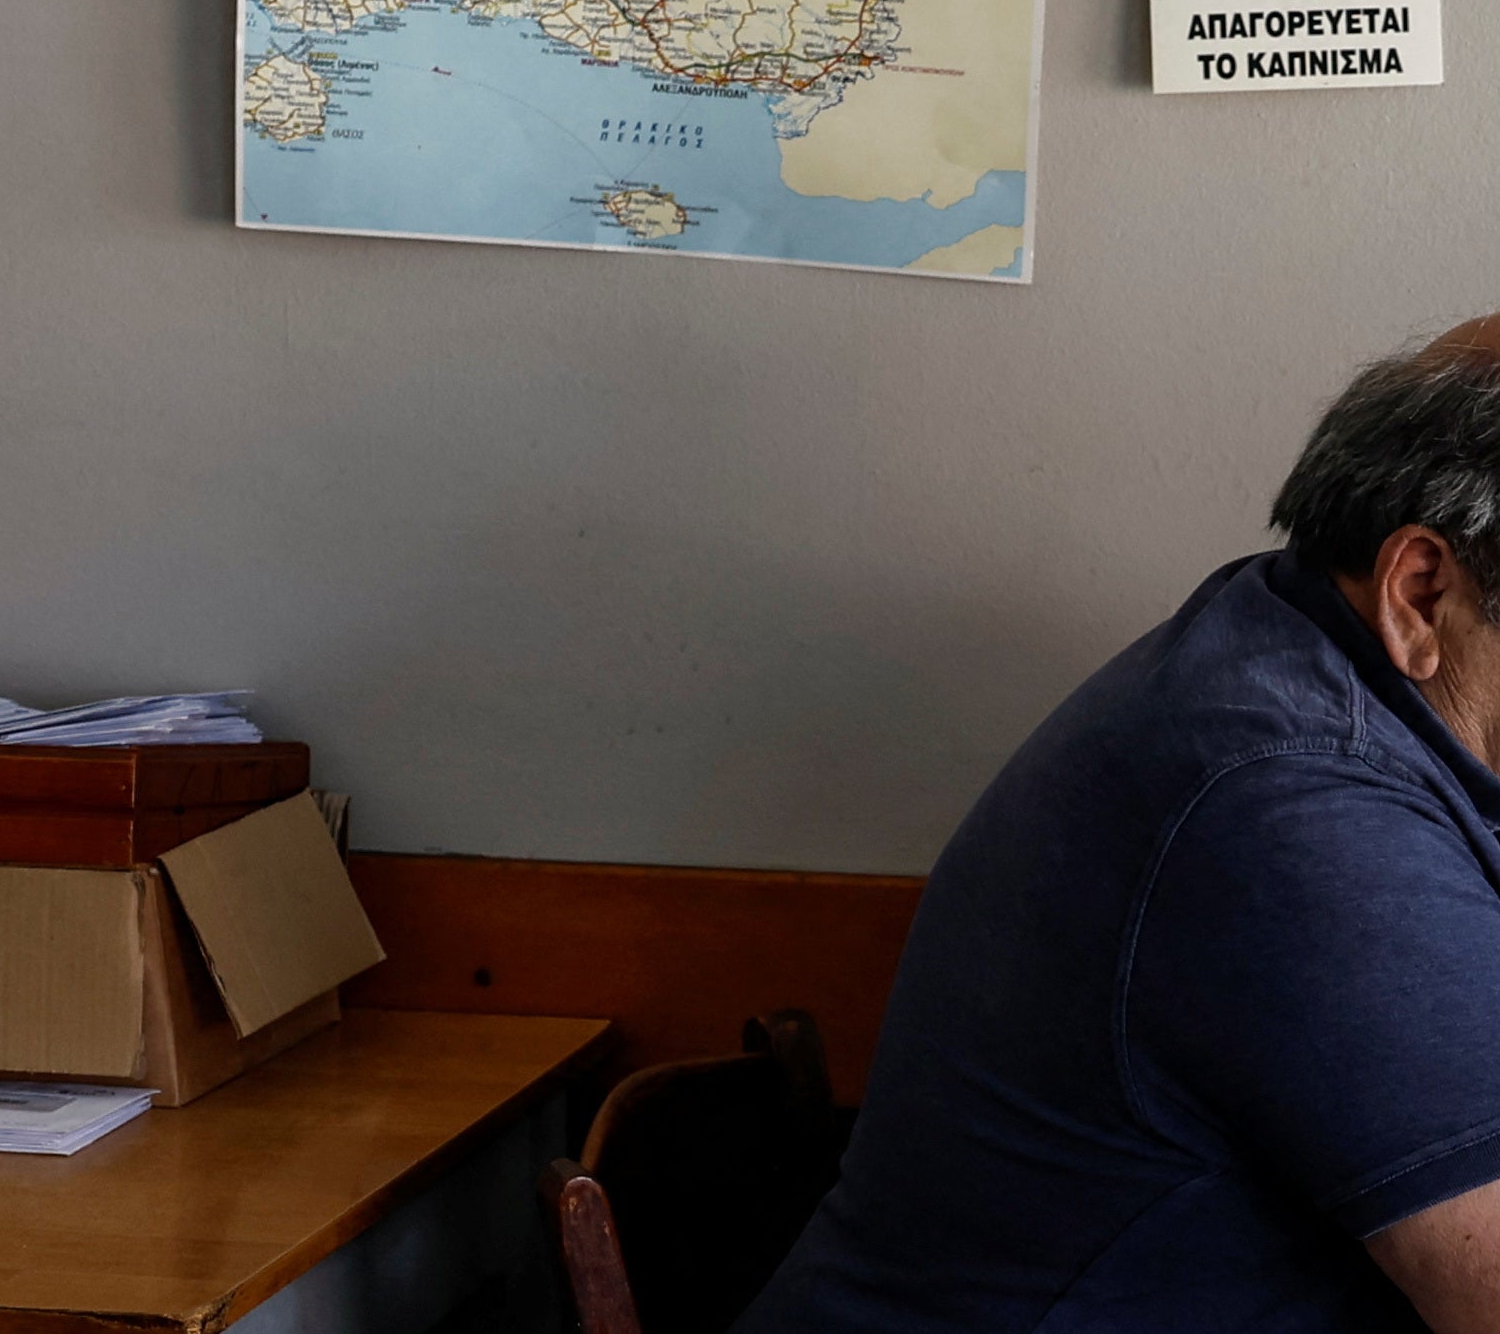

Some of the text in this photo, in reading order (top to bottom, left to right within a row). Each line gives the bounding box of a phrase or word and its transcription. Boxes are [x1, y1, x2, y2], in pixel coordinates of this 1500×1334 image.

[1188, 7, 1410, 40] ΑΠΑΓΟΡΕΥΕΤΑΙ
[1197, 48, 1403, 80] ΤΟ ΚΑΠΝΙΣΜΑ
[652, 83, 747, 99] ΑΛΕΞΑΝΔΡΟΥΠΟΛΗ
[602, 119, 703, 135] ΘΡΑΚΙΚΟ
[600, 133, 703, 148] ΠΕΛΑΓΟΣ
